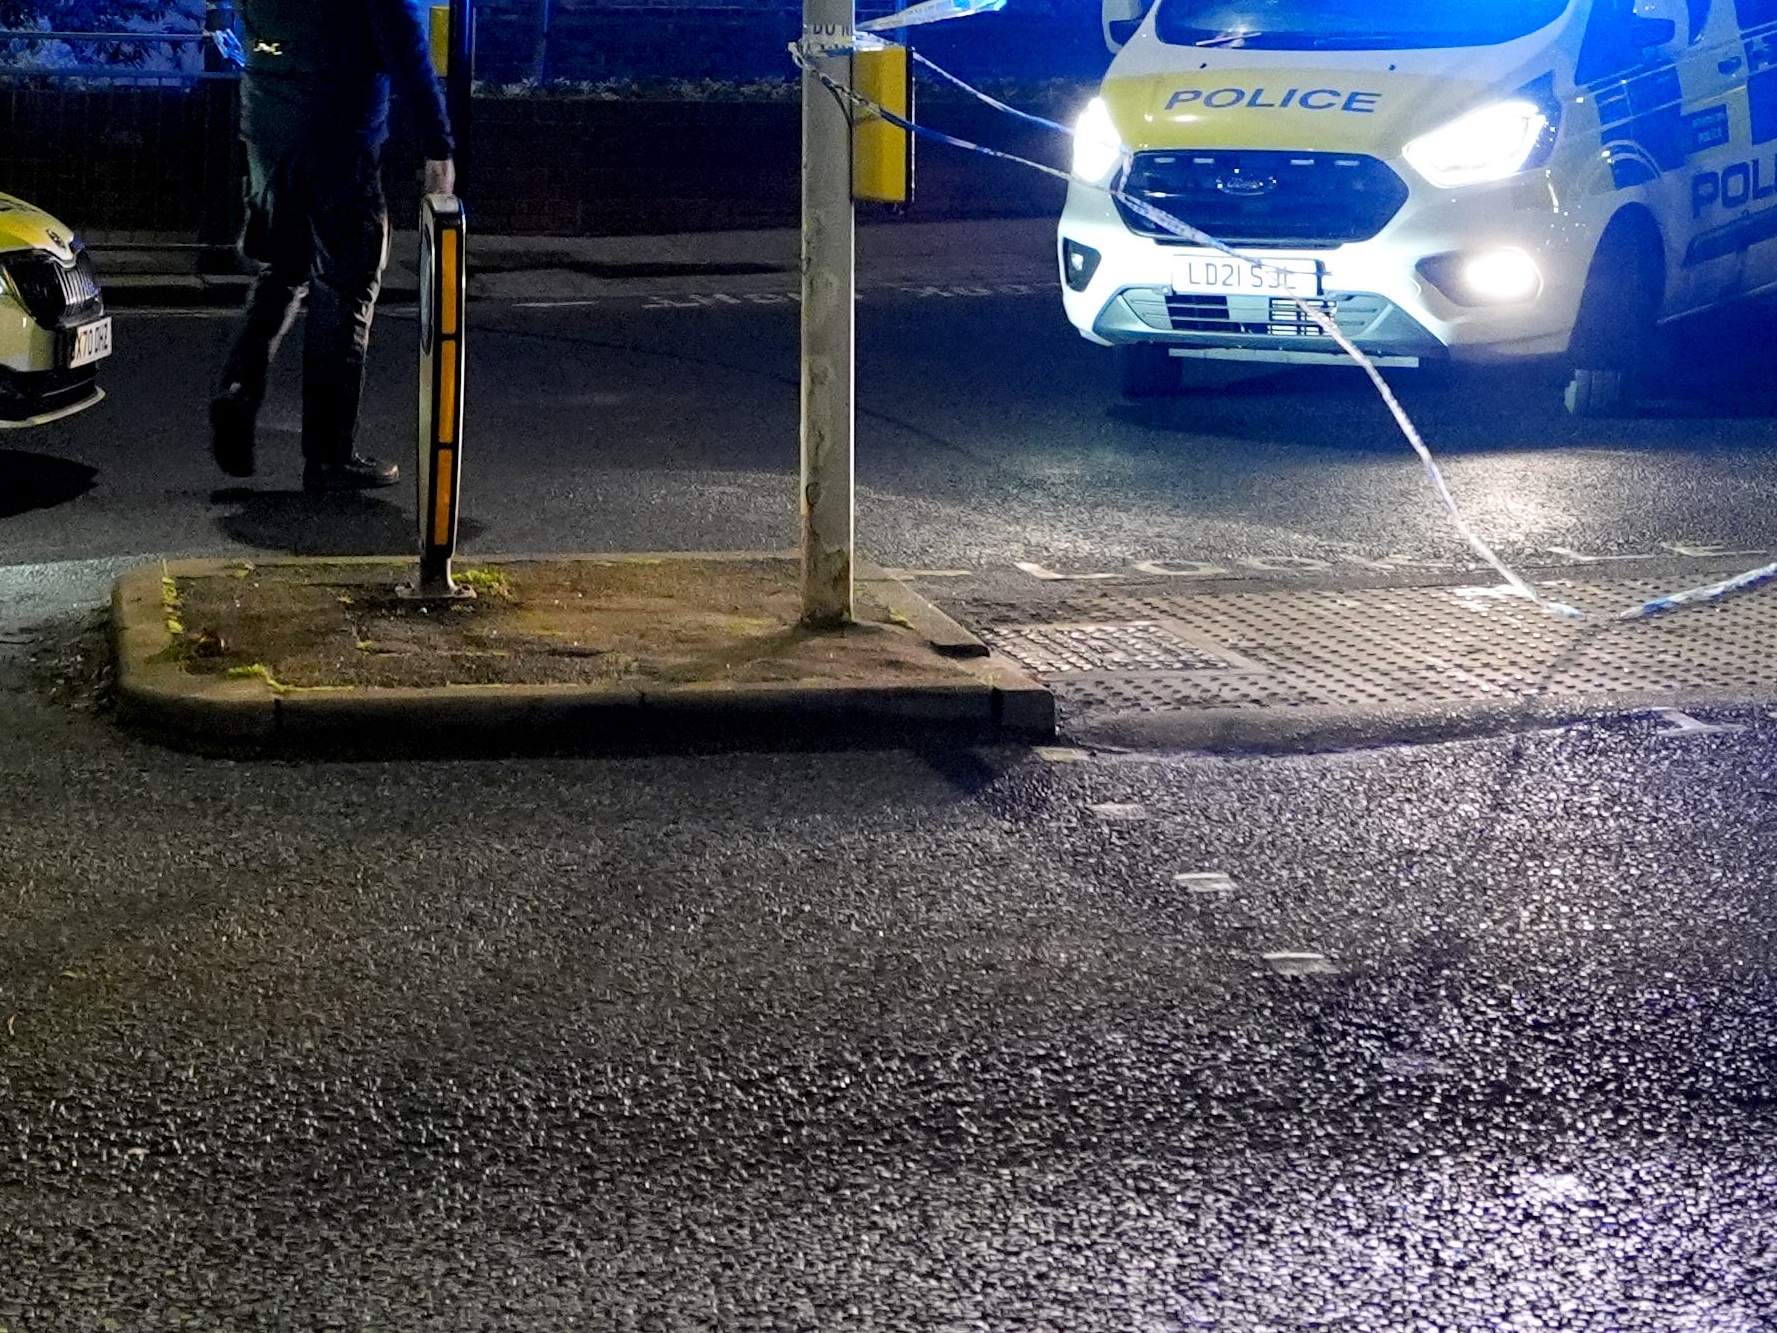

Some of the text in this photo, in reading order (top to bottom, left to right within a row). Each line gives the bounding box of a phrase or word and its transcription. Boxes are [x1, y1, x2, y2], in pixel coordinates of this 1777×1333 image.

[1164, 88, 1382, 113] POLICE
[1189, 262, 1241, 287] LD21
[76, 329, 92, 358] X70
